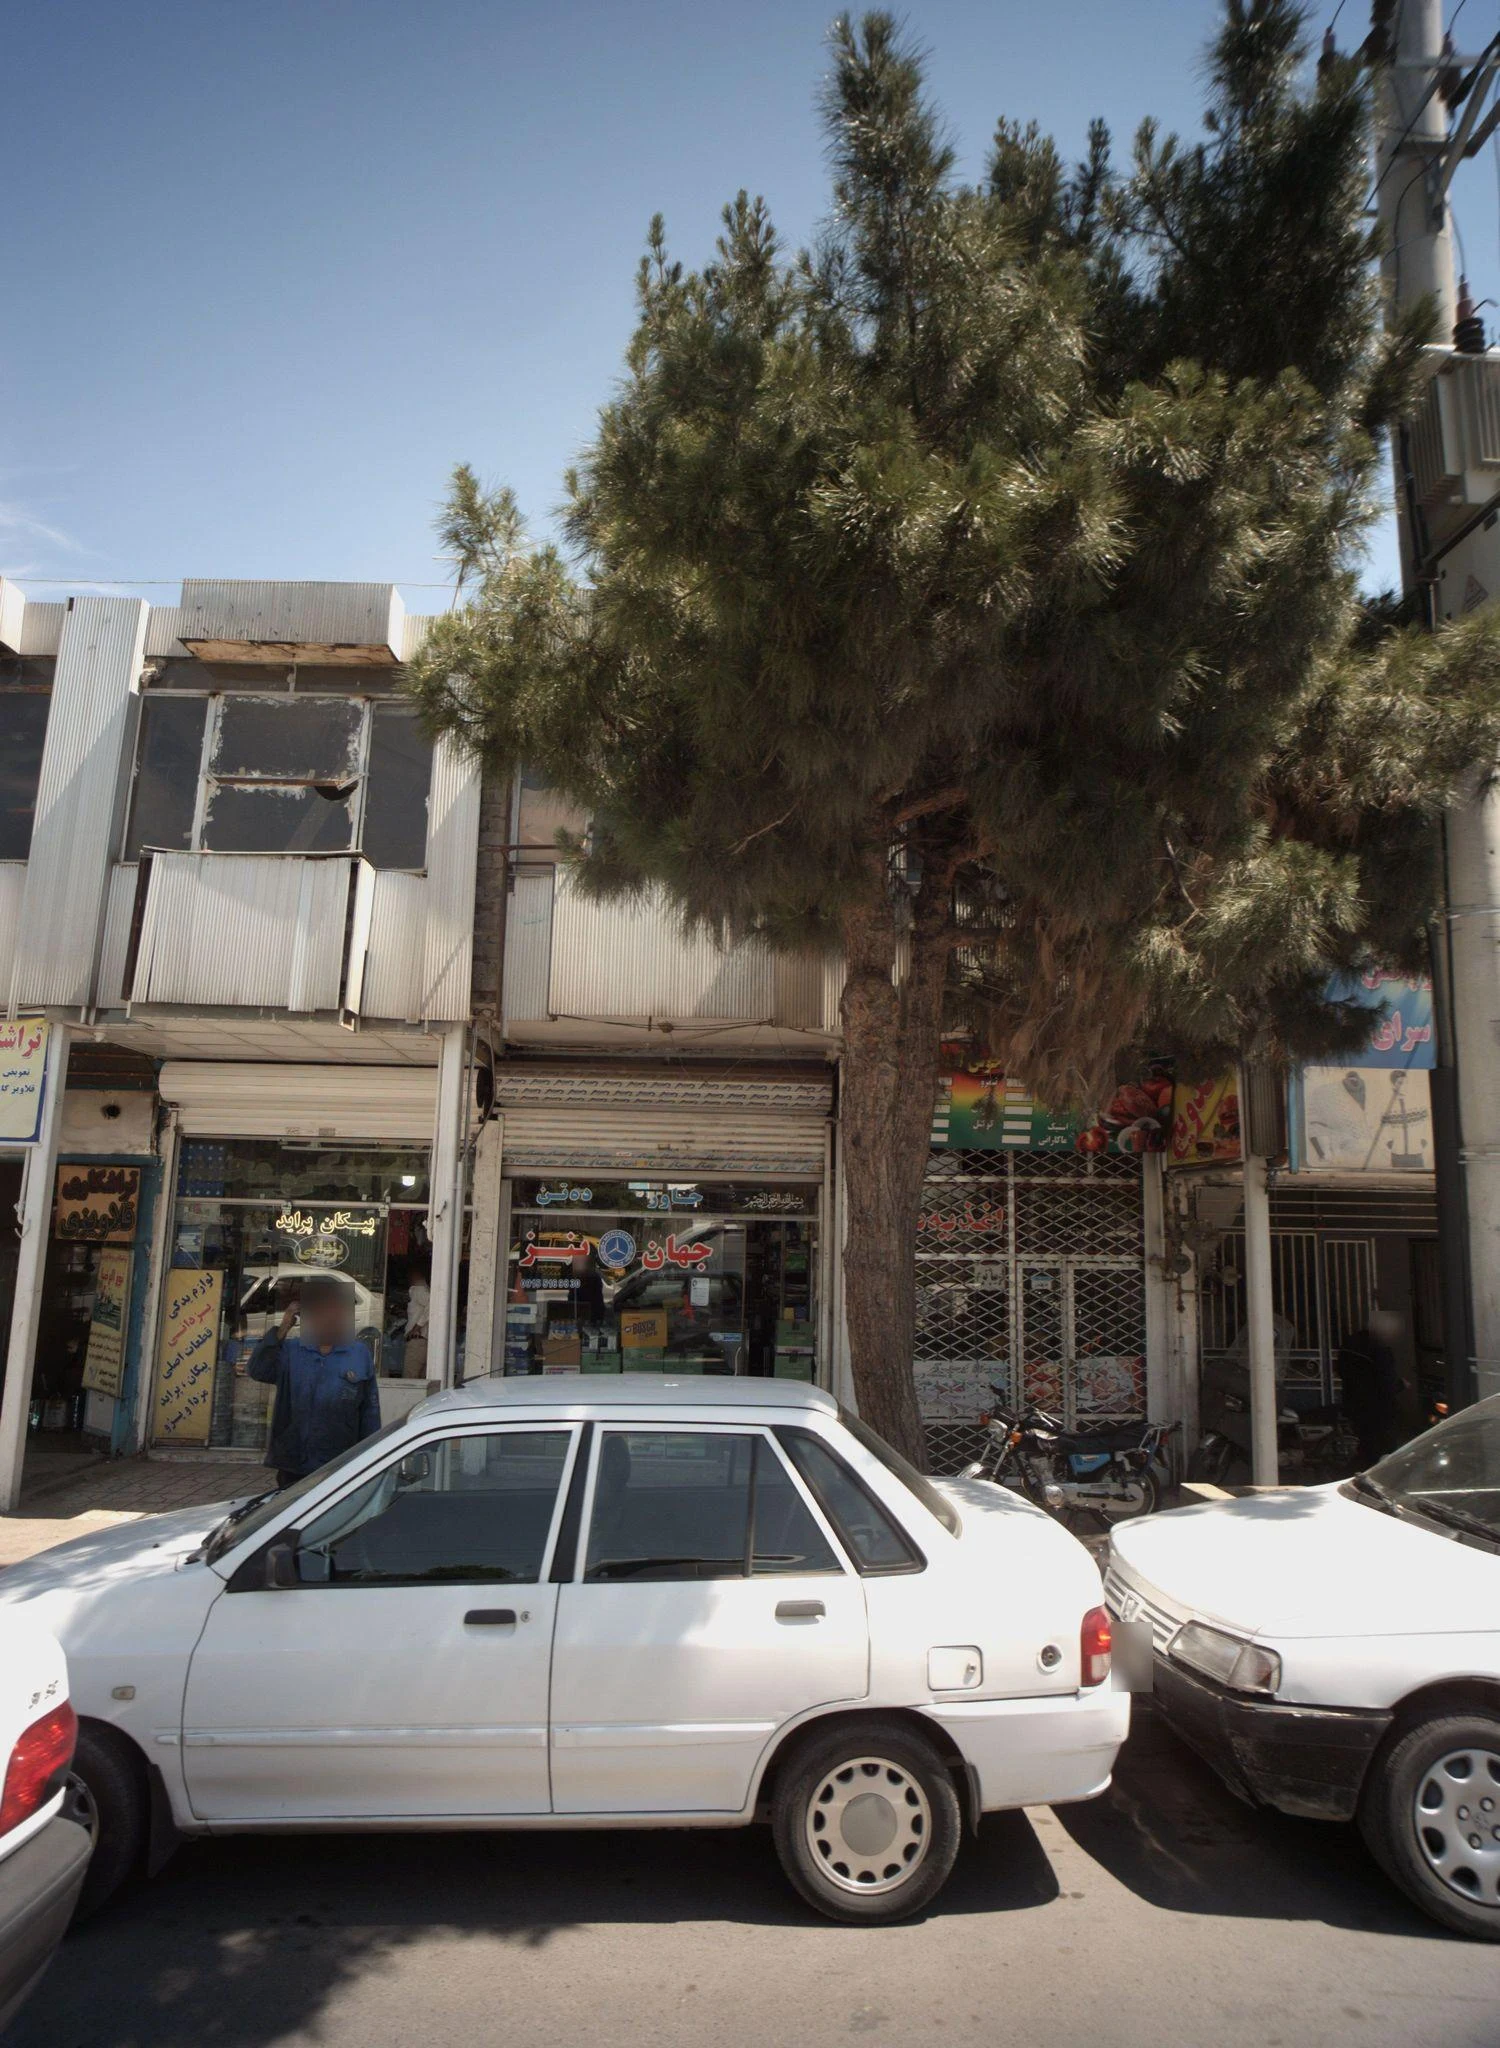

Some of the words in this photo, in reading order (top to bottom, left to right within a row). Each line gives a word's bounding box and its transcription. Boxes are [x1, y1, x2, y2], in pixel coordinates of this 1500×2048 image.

[0, 1024, 43, 1058] تراش
[1372, 1010, 1431, 1052] سرای
[647, 1187, 703, 1209] خاور
[276, 1211, 314, 1235] پراید
[320, 1212, 375, 1236] پیکان
[519, 1231, 590, 1266] بنز
[641, 1233, 713, 1272] جهان
[193, 1272, 214, 1299] لوازم
[169, 1295, 193, 1319] یدکی
[185, 1327, 213, 1356] قطعات
[163, 1352, 184, 1379] اصلی
